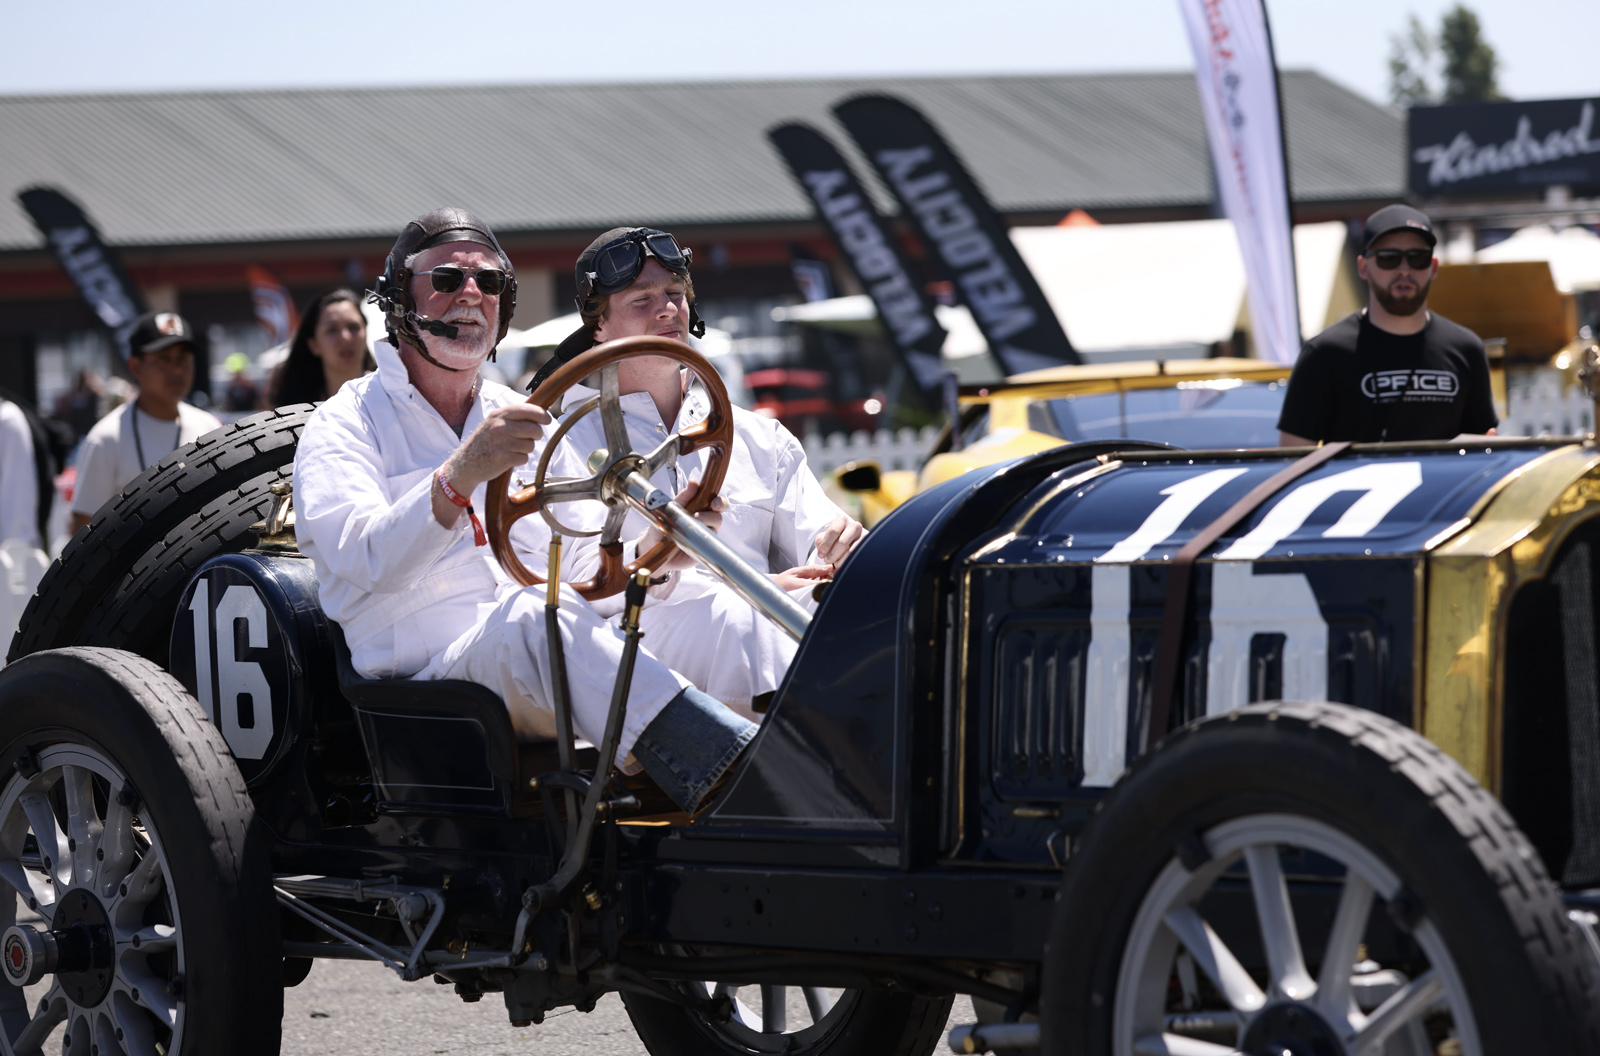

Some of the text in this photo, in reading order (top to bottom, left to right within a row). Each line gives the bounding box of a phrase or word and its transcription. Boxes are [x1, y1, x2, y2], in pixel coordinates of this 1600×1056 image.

[804, 169, 930, 345] VELOCITY
[878, 147, 1036, 341] VELOCITY
[188, 578, 274, 760] 16
[1081, 461, 1423, 788] 16
